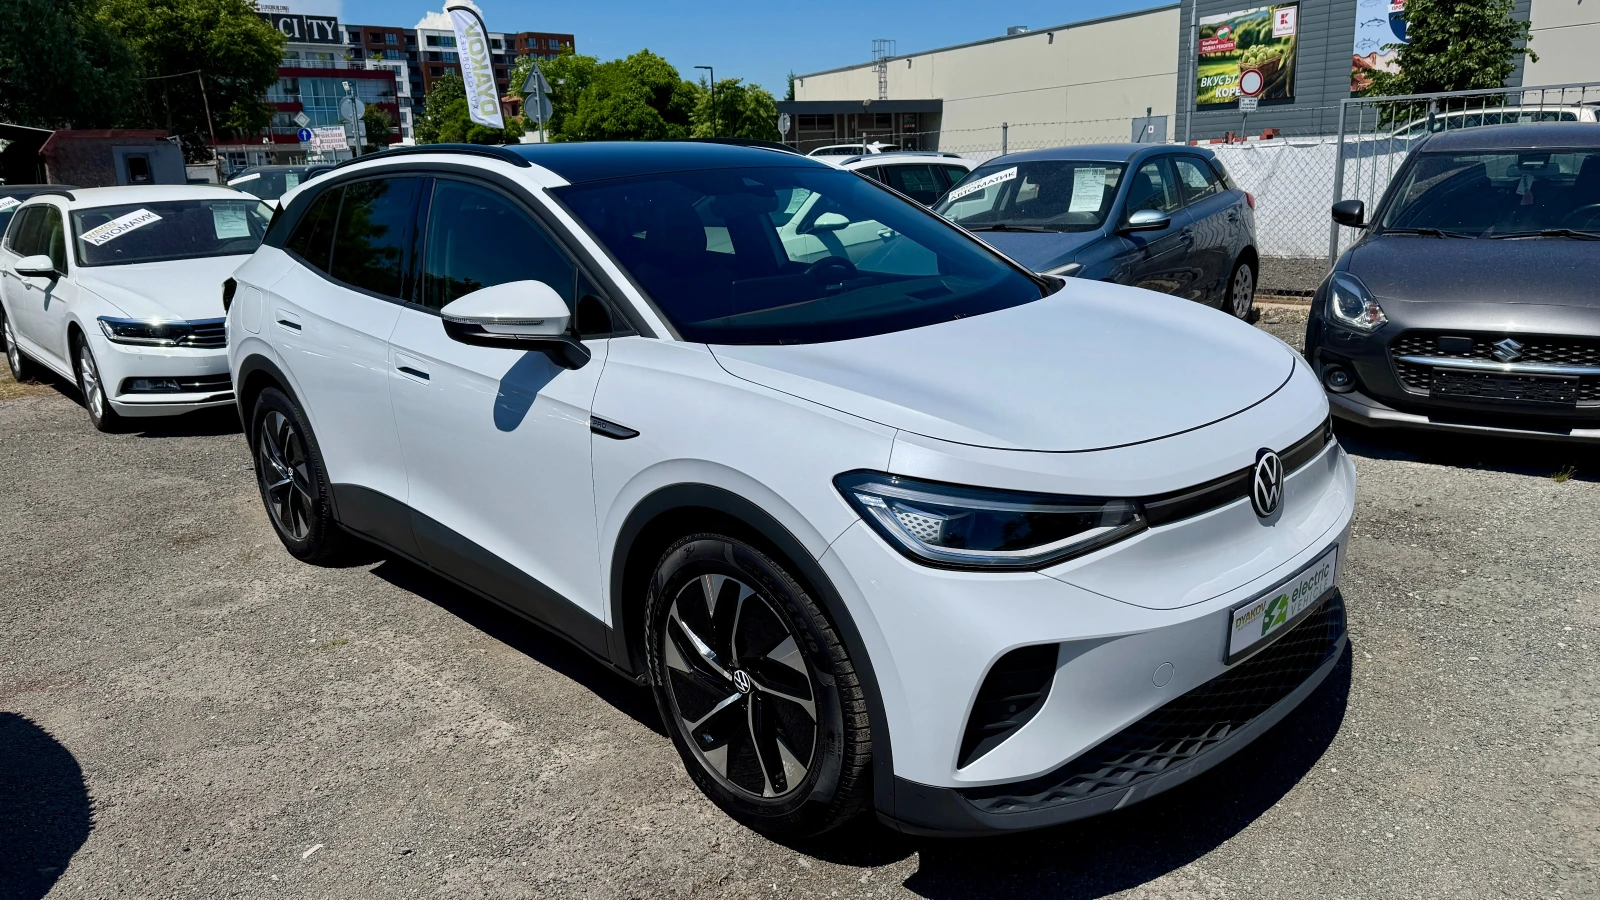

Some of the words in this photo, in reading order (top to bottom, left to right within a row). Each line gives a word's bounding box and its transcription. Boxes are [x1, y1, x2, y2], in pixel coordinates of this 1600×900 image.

[279, 17, 335, 40] CITY
[1200, 74, 1238, 87] ВКУСЪТ
[1215, 87, 1243, 98] КОРЕ
[950, 171, 1015, 201] АВТОМАТИК
[94, 212, 153, 245] АВТОМАТИК
[592, 419, 607, 429] PRO
[1291, 563, 1330, 603] electric
[1291, 579, 1329, 616] VEHICLE
[1235, 600, 1267, 629] DYAKOV
